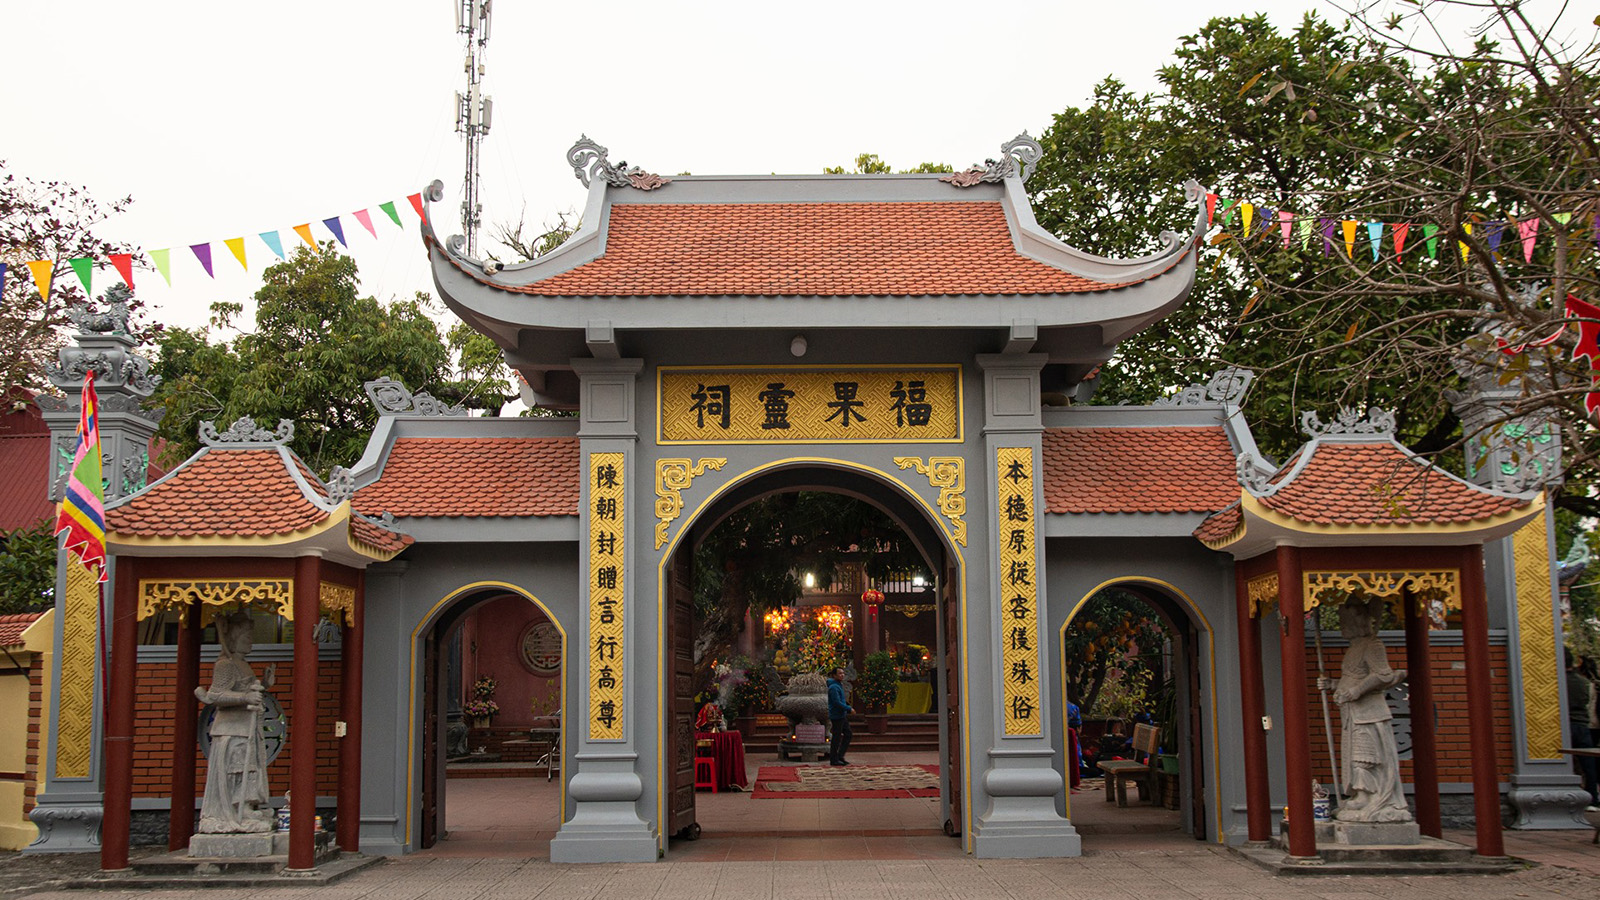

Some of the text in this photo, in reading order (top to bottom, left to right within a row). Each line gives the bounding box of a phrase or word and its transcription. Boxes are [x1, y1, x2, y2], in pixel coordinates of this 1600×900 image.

[596, 464, 620, 729] 陳朝封贈言行高尊
